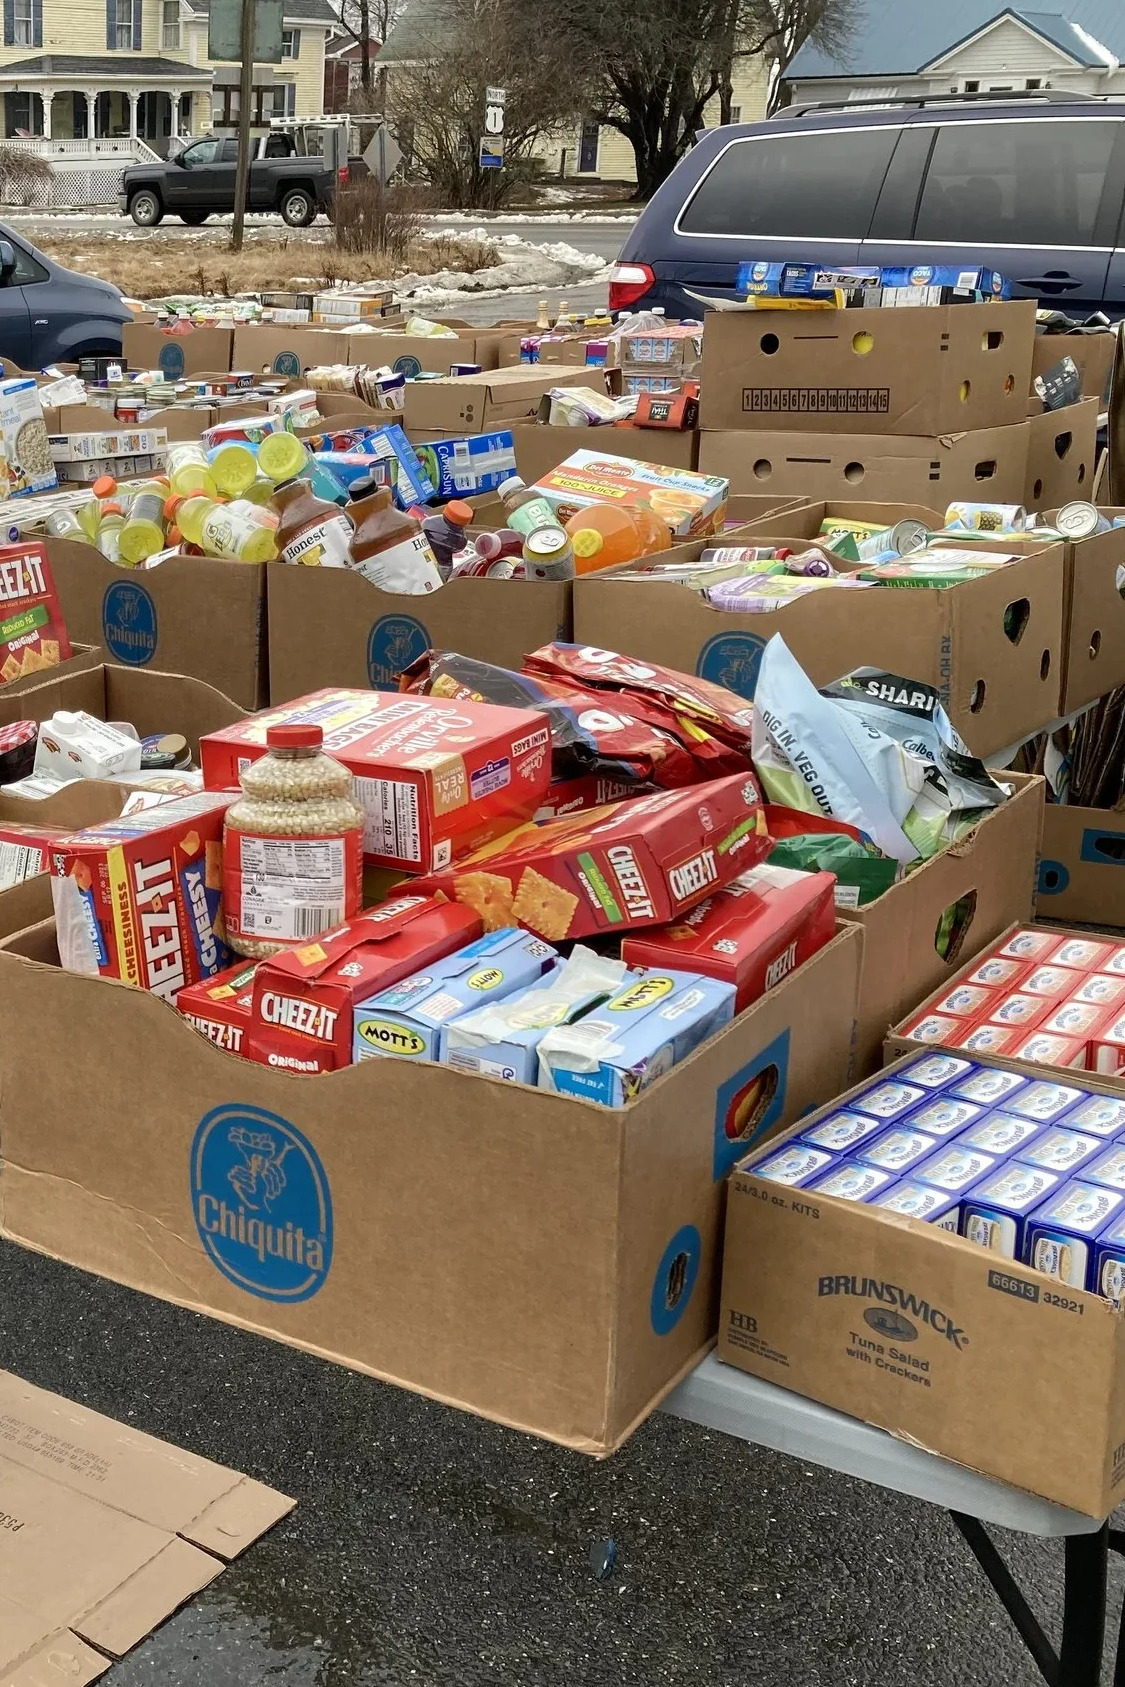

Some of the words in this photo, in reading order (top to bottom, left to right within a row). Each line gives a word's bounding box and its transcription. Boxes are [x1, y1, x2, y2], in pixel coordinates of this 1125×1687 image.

[488, 90, 505, 100] NORTH
[493, 112, 497, 128] 1
[746, 394, 750, 406] 1
[755, 395, 759, 406] 2
[764, 395, 768, 407] 3
[773, 395, 778, 407] 4
[783, 395, 787, 407] 5
[792, 395, 796, 407] 6
[801, 395, 806, 407] 7
[811, 395, 815, 407] 8
[820, 395, 825, 407] 9
[829, 395, 837, 407] 10
[839, 395, 846, 407] 11
[849, 395, 856, 407] 12
[859, 395, 866, 407] 13
[868, 395, 876, 407] 14
[879, 395, 886, 407] 15
[551, 469, 598, 486] Mandarin
[600, 480, 639, 493] Oranges
[588, 463, 601, 473] Del
[602, 466, 632, 477] Monte
[589, 485, 620, 497] JUICE
[679, 480, 711, 493] Snacks
[286, 526, 326, 560] Honest
[105, 623, 154, 649] Chiquita
[376, 702, 421, 727] MINI
[323, 721, 380, 750] BAGS
[403, 715, 473, 755] Orville
[513, 738, 529, 755] BAGS
[529, 731, 548, 748] MINI
[763, 711, 779, 731] DIG
[794, 751, 818, 782] VEG
[810, 782, 834, 815] OUT
[436, 773, 465, 789] REAL
[441, 784, 462, 804] Only
[409, 785, 418, 830] Nutrition
[384, 818, 392, 836] 210
[386, 843, 393, 855] 35
[412, 833, 420, 859] Facts
[117, 882, 137, 979] CHEESINESS
[134, 858, 185, 1005] HEEZ-IT
[186, 871, 218, 968] CHEESY
[364, 1025, 419, 1050] MOTT'S
[735, 1181, 768, 1202] 24/3.0
[792, 1202, 821, 1220] KITS
[198, 1193, 325, 1272] Chiquita
[992, 1275, 1036, 1298] 66613
[1043, 1292, 1085, 1315] 32921
[729, 1309, 758, 1333] HB
[849, 1331, 885, 1355] Tuna
[888, 1347, 930, 1372] Salad
[846, 1347, 871, 1364] with
[875, 1357, 931, 1388] Crackers
